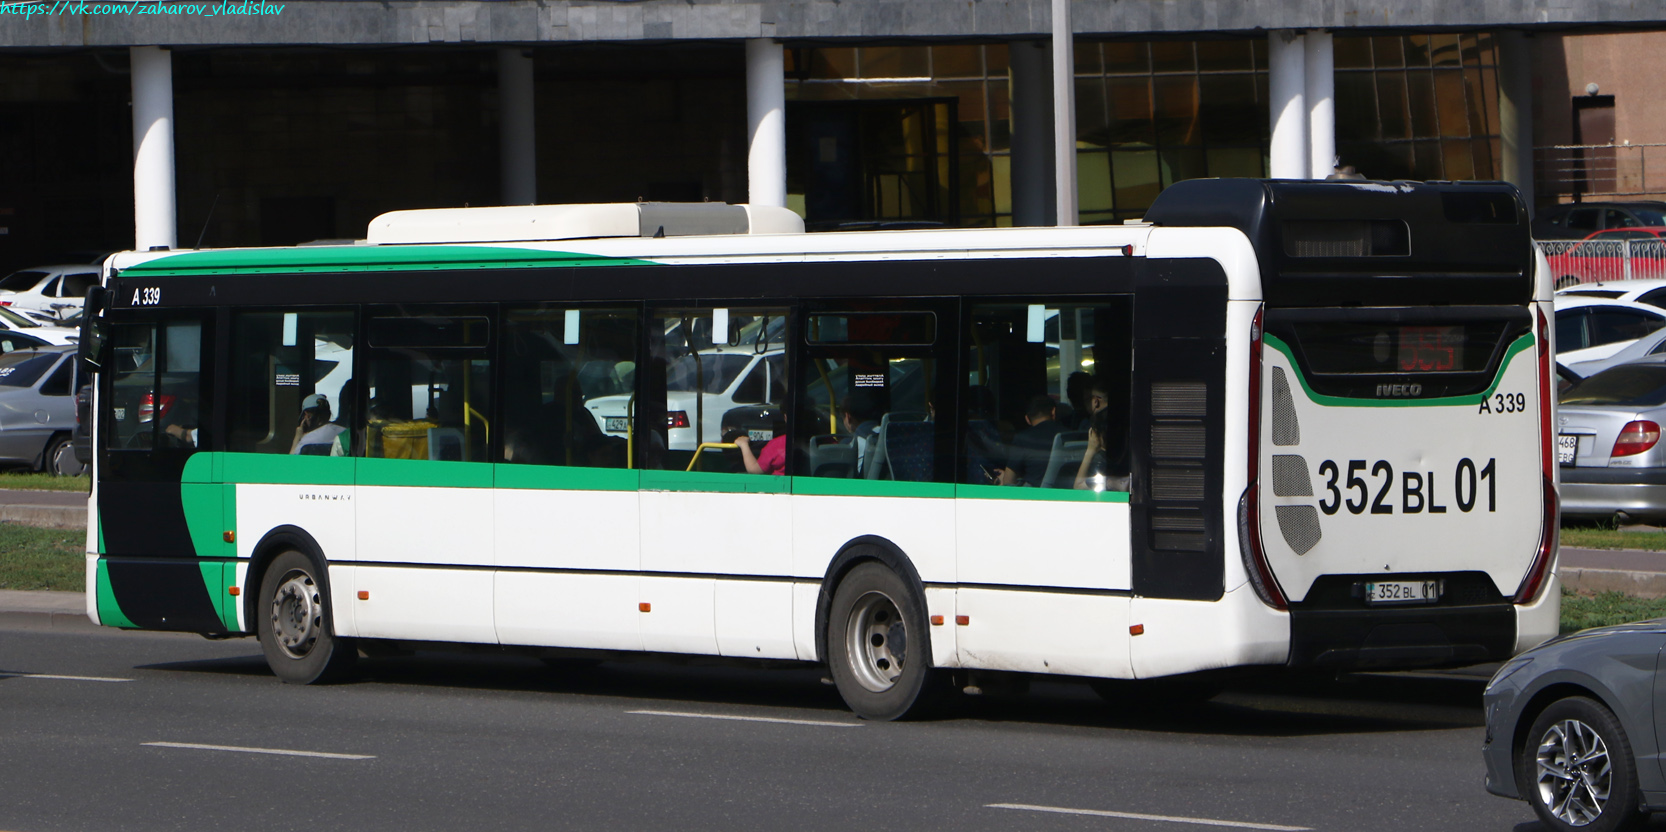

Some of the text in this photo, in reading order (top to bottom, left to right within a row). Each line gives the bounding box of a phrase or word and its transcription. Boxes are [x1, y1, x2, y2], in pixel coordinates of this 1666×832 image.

[131, 287, 161, 306] A 339
[1376, 383, 1422, 397] IVECO
[1478, 393, 1526, 414] A 339
[1318, 457, 1496, 516] 352 BL 01
[1378, 583, 1435, 598] 352 BL 01
